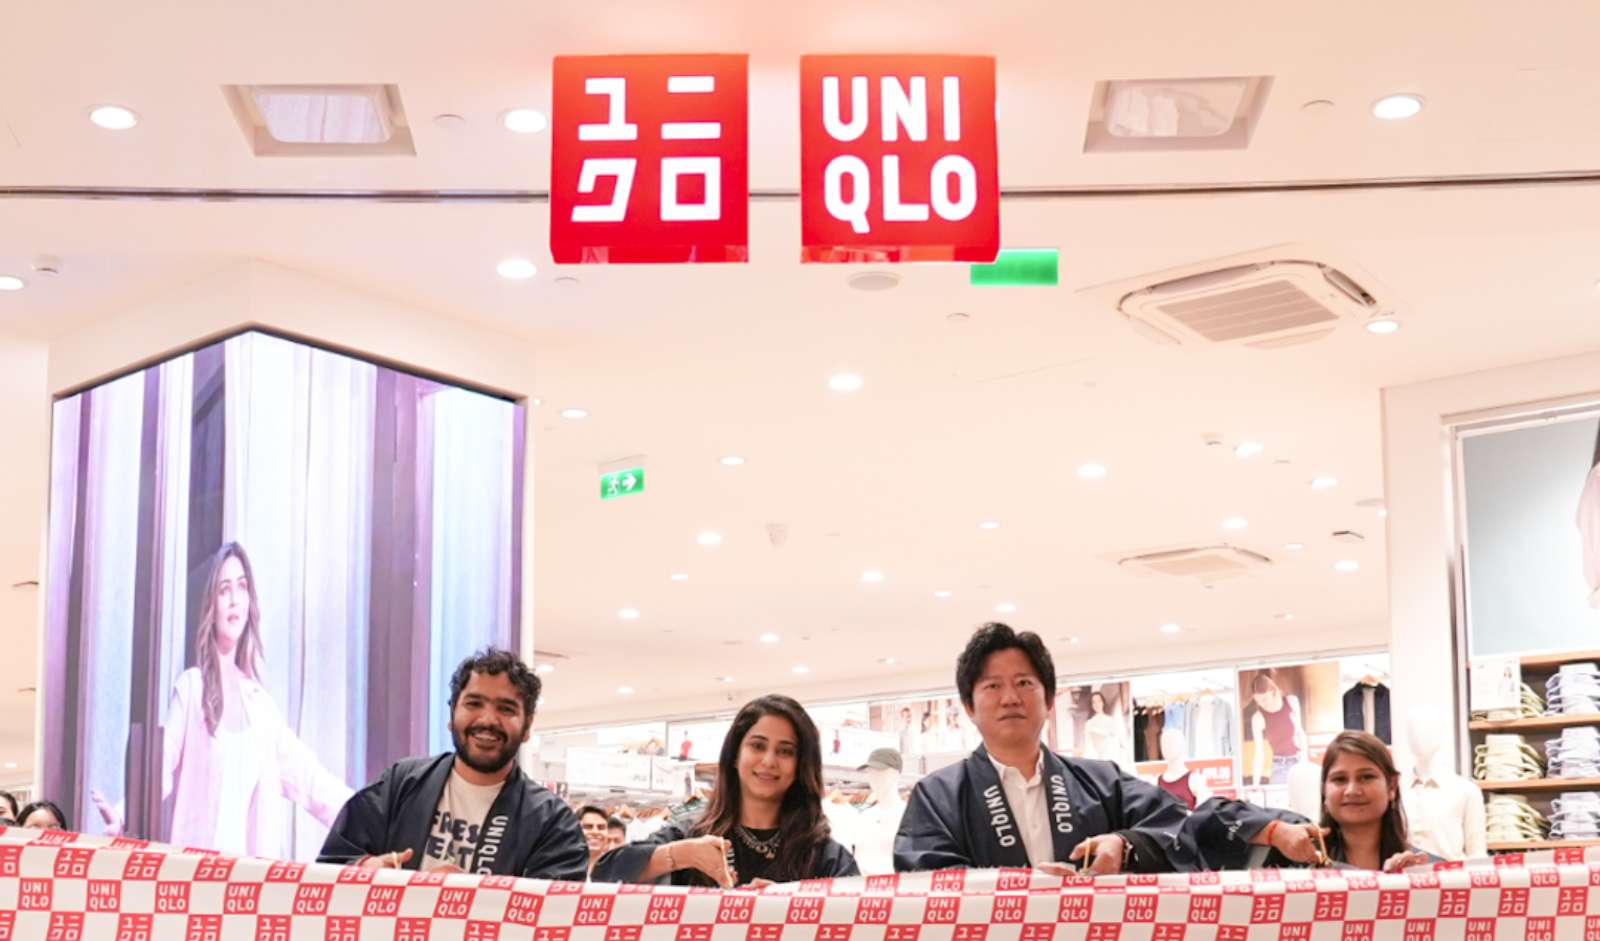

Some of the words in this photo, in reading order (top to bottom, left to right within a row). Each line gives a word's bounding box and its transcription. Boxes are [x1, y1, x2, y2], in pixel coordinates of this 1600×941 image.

[578, 75, 721, 141] ユニ
[822, 75, 960, 142] UNI
[571, 156, 721, 222] クロ
[823, 154, 977, 234] QLO
[1050, 774, 1074, 834] UNIQLO
[983, 785, 1017, 847] UNIQLO
[57, 863, 84, 875] クロ
[126, 866, 156, 877] クロ
[197, 867, 227, 878] クロ
[23, 881, 48, 893] UNI
[90, 883, 116, 895] UNI
[159, 884, 185, 896] UNI
[228, 885, 256, 897] UNI
[299, 886, 327, 898] UNI
[370, 888, 399, 900] UNI
[442, 890, 469, 902] UNI
[1319, 893, 1344, 905] ユニ
[1383, 892, 1406, 904] ユニ
[1443, 891, 1467, 903] ユニ
[1502, 890, 1526, 902] ユニ
[1561, 889, 1585, 901] ユニ
[21, 895, 49, 908] QLO
[89, 897, 118, 910] QLO
[158, 897, 186, 911] QLO
[226, 899, 255, 912] QLO
[296, 900, 326, 913] QLO
[367, 901, 396, 914] QLO
[511, 895, 539, 909] UNI
[582, 897, 609, 909] UNI
[653, 897, 680, 908] UNI
[723, 897, 750, 908] UNI
[793, 898, 819, 908] UNI
[861, 898, 888, 908] UNI
[929, 898, 955, 908] UNI
[997, 897, 1022, 907] UNI
[1063, 897, 1088, 907] UNI
[1128, 897, 1153, 908] UNI
[1192, 897, 1217, 908] UNI
[1255, 896, 1281, 908] ユニ
[1560, 901, 1584, 913] クロ
[437, 903, 467, 916] QLO
[508, 907, 536, 921] QLO
[1316, 906, 1342, 918] クロ
[1380, 904, 1405, 916] クロ
[1441, 903, 1466, 915] クロ
[1500, 902, 1525, 914] クロ
[578, 910, 607, 924] QLO
[650, 909, 679, 922] QLO
[720, 909, 749, 921] QLO
[790, 909, 819, 922] QLO
[859, 910, 887, 922] QLO
[927, 909, 955, 922] QLO
[994, 909, 1022, 921] QLO
[1060, 909, 1088, 921] QLO
[1126, 909, 1153, 920] QLO
[1191, 909, 1217, 921] QLO
[1253, 909, 1280, 921] クロ
[1283, 925, 1307, 936] UNI
[1345, 923, 1369, 934] UNI
[1407, 921, 1431, 932] UNI
[1467, 920, 1492, 931] UNI
[1528, 919, 1552, 931] UNI
